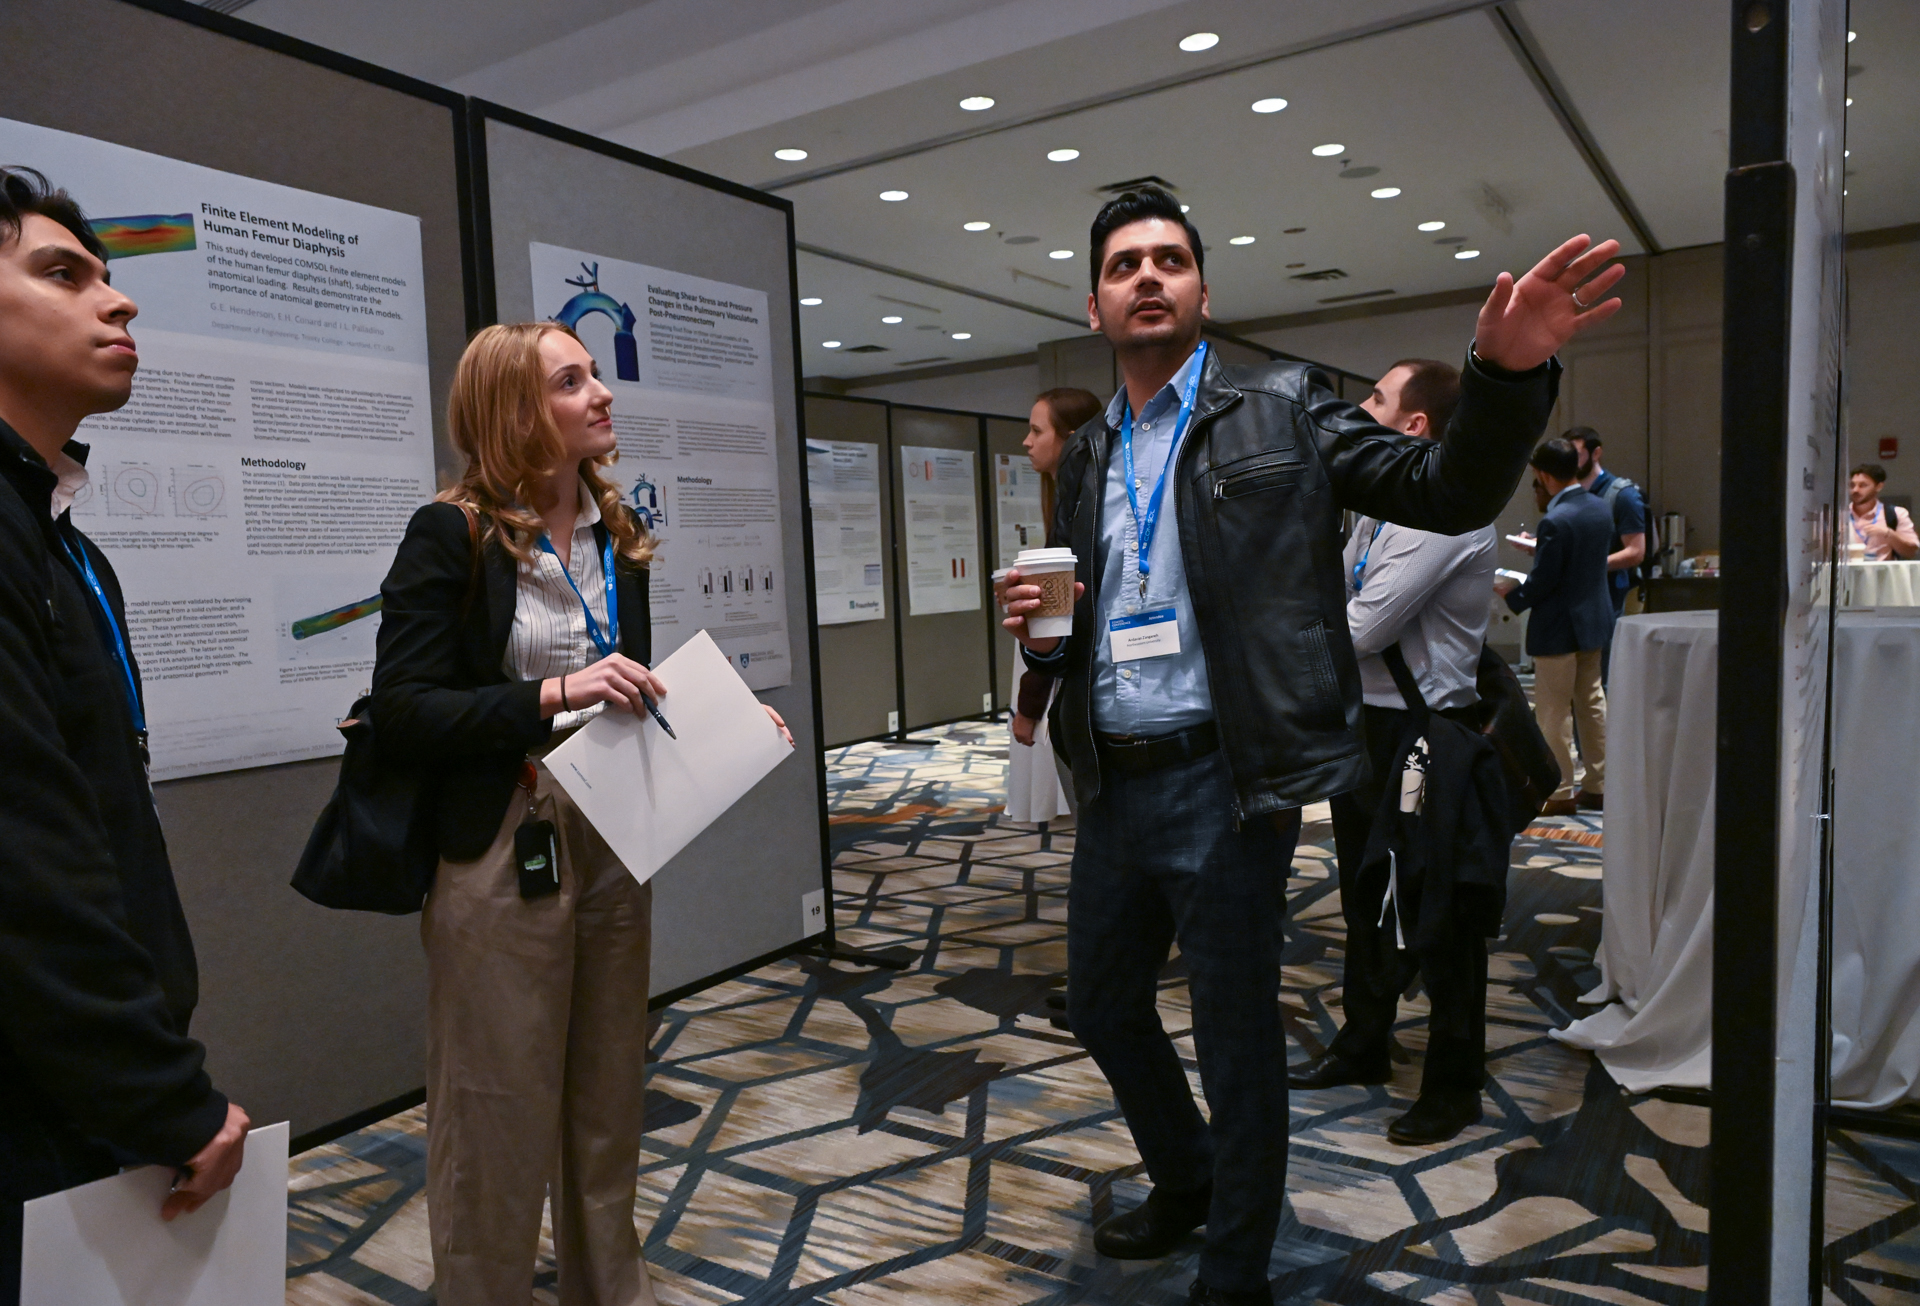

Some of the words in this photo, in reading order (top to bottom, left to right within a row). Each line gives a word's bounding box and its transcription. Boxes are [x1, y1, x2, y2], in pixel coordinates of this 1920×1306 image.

[200, 202, 238, 221] Finite
[239, 210, 290, 232] Element
[291, 221, 346, 246] Modeling
[347, 234, 360, 246] of
[202, 219, 250, 239] Human
[251, 229, 291, 247] Femur
[292, 237, 346, 258] Diaphysis
[206, 241, 224, 252] This
[225, 246, 249, 259] study
[250, 249, 293, 265] developed
[294, 258, 329, 272] COMSOL
[329, 264, 350, 276] finite
[350, 269, 381, 282] element
[381, 276, 407, 287] models
[207, 255, 217, 264] of
[218, 256, 233, 267] the
[234, 259, 264, 273] human
[265, 264, 290, 277] femur
[291, 269, 327, 284] diaphysis
[327, 276, 355, 291] (shaft),
[355, 283, 391, 296] subjected
[391, 288, 400, 297] to
[208, 269, 255, 284] anatomical
[256, 275, 289, 291] loading.
[292, 282, 320, 295] Results
[321, 287, 369, 303] demonstrate
[369, 296, 382, 306] the
[209, 280, 258, 297] importance
[258, 289, 268, 298] of
[269, 292, 313, 306] anatomical
[314, 300, 351, 314] geometry
[351, 304, 360, 314] in
[360, 306, 375, 316] FEA
[375, 310, 404, 321] models.
[647, 284, 680, 300] Evaluating
[680, 291, 698, 302] Shear
[698, 295, 717, 306] Stress
[716, 299, 729, 308] and
[728, 301, 754, 313] Pressure
[648, 296, 675, 309] Changes
[675, 301, 682, 310] in
[682, 302, 693, 312] the
[693, 305, 726, 320] Pulmonary
[726, 311, 759, 325] Vasculature
[649, 307, 716, 329] Post-Pneumonectomy
[1185, 374, 1197, 402] COMSOL
[240, 457, 307, 471] Methodology
[677, 476, 713, 485] Methodology
[1144, 508, 1156, 542] COMSOL
[162, 671, 194, 680] anatomical
[194, 670, 223, 678] geometry
[811, 905, 821, 916] 19
